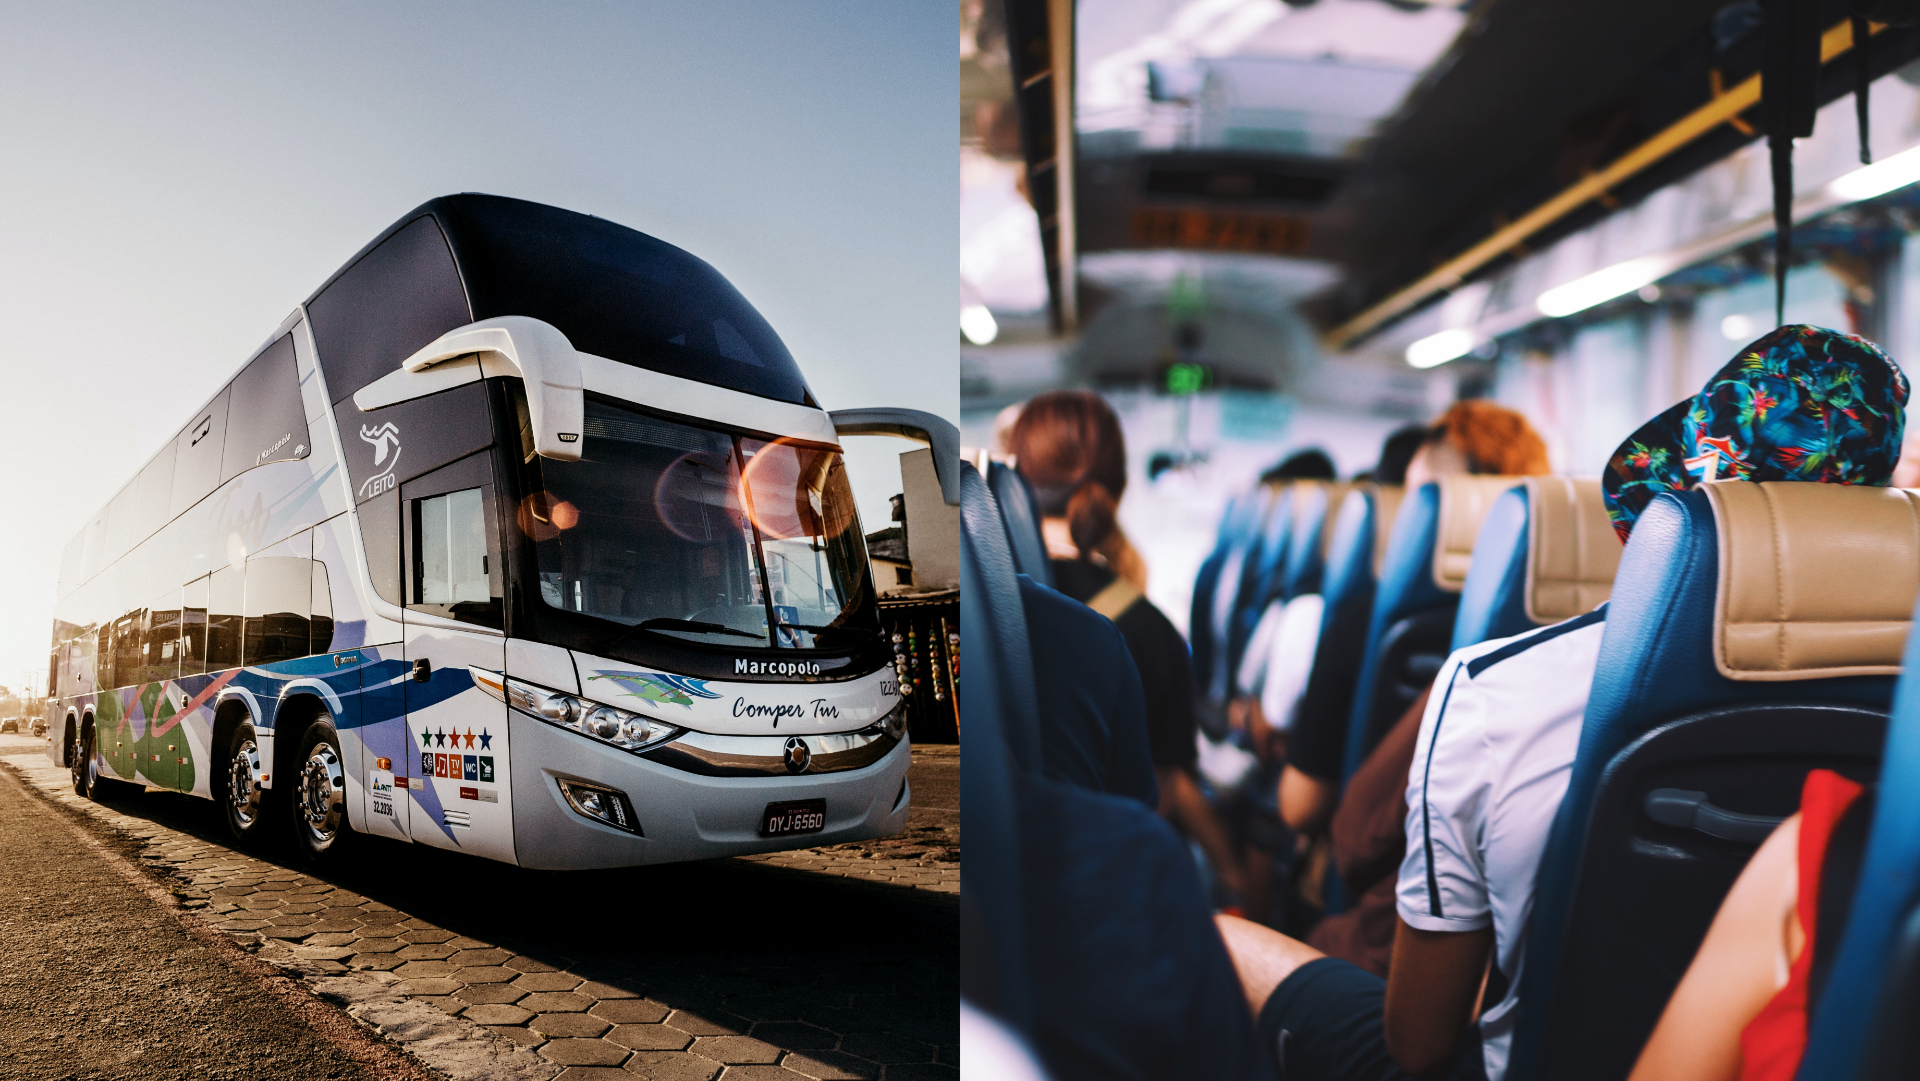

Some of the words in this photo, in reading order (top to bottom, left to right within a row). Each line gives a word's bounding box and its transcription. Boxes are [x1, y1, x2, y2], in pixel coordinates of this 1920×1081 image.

[368, 473, 395, 498] LEITO
[734, 658, 821, 677] Marcopolo
[732, 696, 805, 729] Comper
[810, 698, 840, 719] Tur
[450, 759, 460, 769] TV
[465, 762, 476, 774] WC
